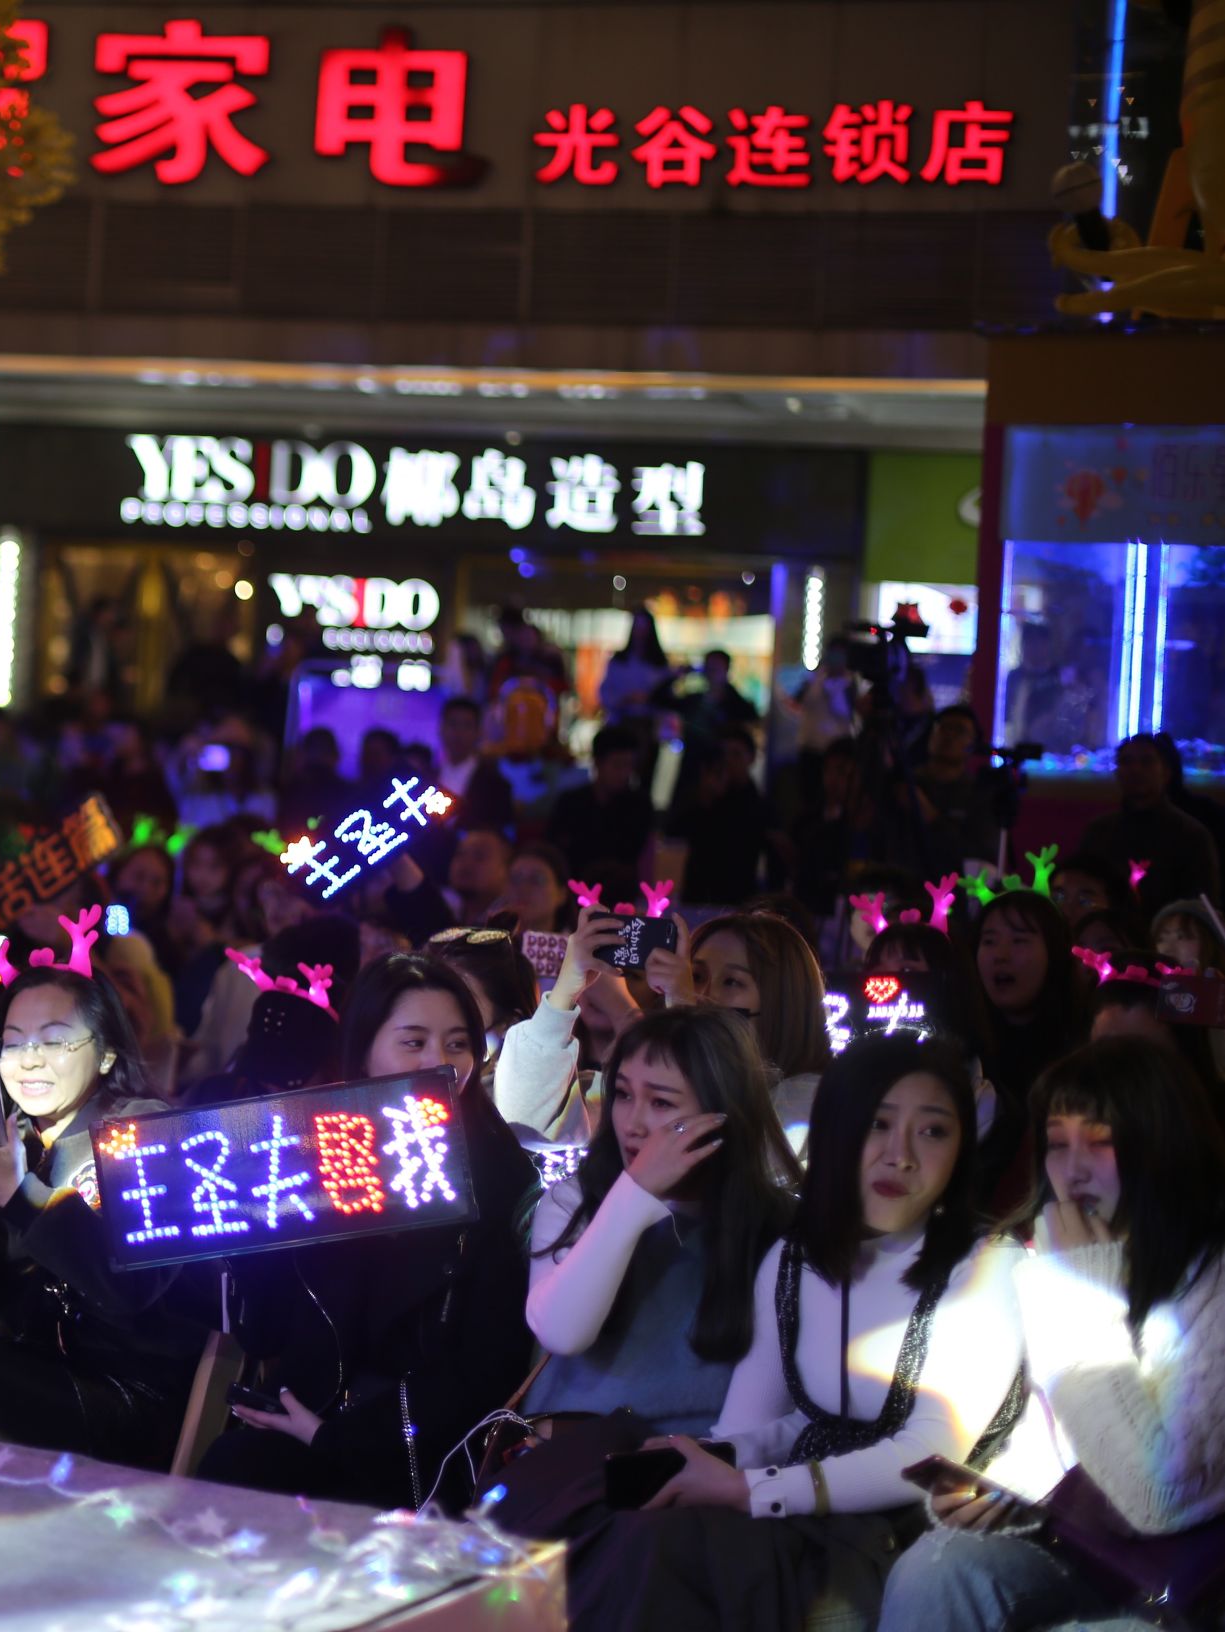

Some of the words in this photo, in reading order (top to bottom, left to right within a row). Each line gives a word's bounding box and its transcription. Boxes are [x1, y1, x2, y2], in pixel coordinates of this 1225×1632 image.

[533, 100, 1015, 189] 光谷连锁店
